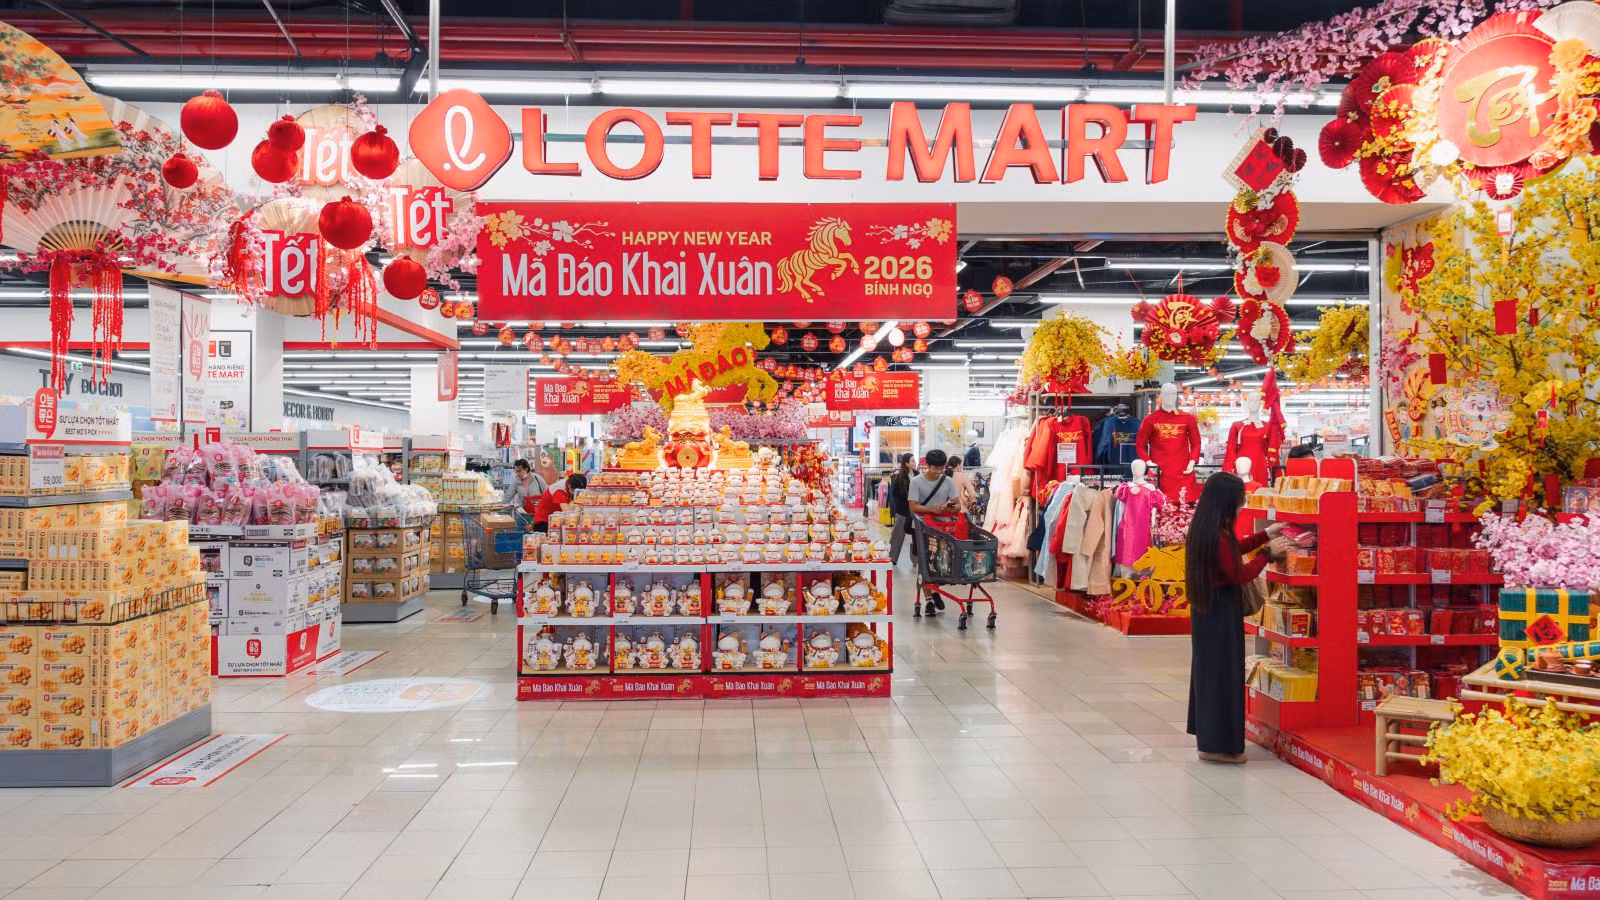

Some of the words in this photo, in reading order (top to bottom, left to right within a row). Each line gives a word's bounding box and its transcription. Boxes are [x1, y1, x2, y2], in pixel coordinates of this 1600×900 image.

[522, 107, 863, 181] LOTTE
[886, 101, 1196, 184] MART
[389, 187, 450, 246] Tết
[621, 231, 679, 246] HAPPY
[683, 231, 722, 246] NEW
[726, 231, 772, 246] YEAR
[263, 232, 318, 295] Tết
[863, 255, 933, 280] 2026
[502, 254, 547, 297] Mã
[558, 252, 613, 297] Đáo
[622, 251, 687, 297] Khai
[698, 253, 773, 297] Xuân
[902, 283, 933, 299] NGỌ
[39, 369, 75, 395] TY
[544, 392, 560, 403] Khai
[834, 388, 850, 399] Khai
[313, 405, 335, 421] HOBBY
[80, 417, 95, 426] CHỌN
[43, 476, 62, 485] 59,000
[1112, 578, 1192, 615] 202
[554, 683, 567, 692] Khai
[568, 683, 583, 692] Xuân
[647, 682, 659, 691] Khai
[660, 682, 674, 691] Xuân
[746, 682, 759, 690] Khai
[760, 682, 774, 690] Xuân
[837, 681, 850, 689] Khai
[851, 681, 865, 689] Xuân
